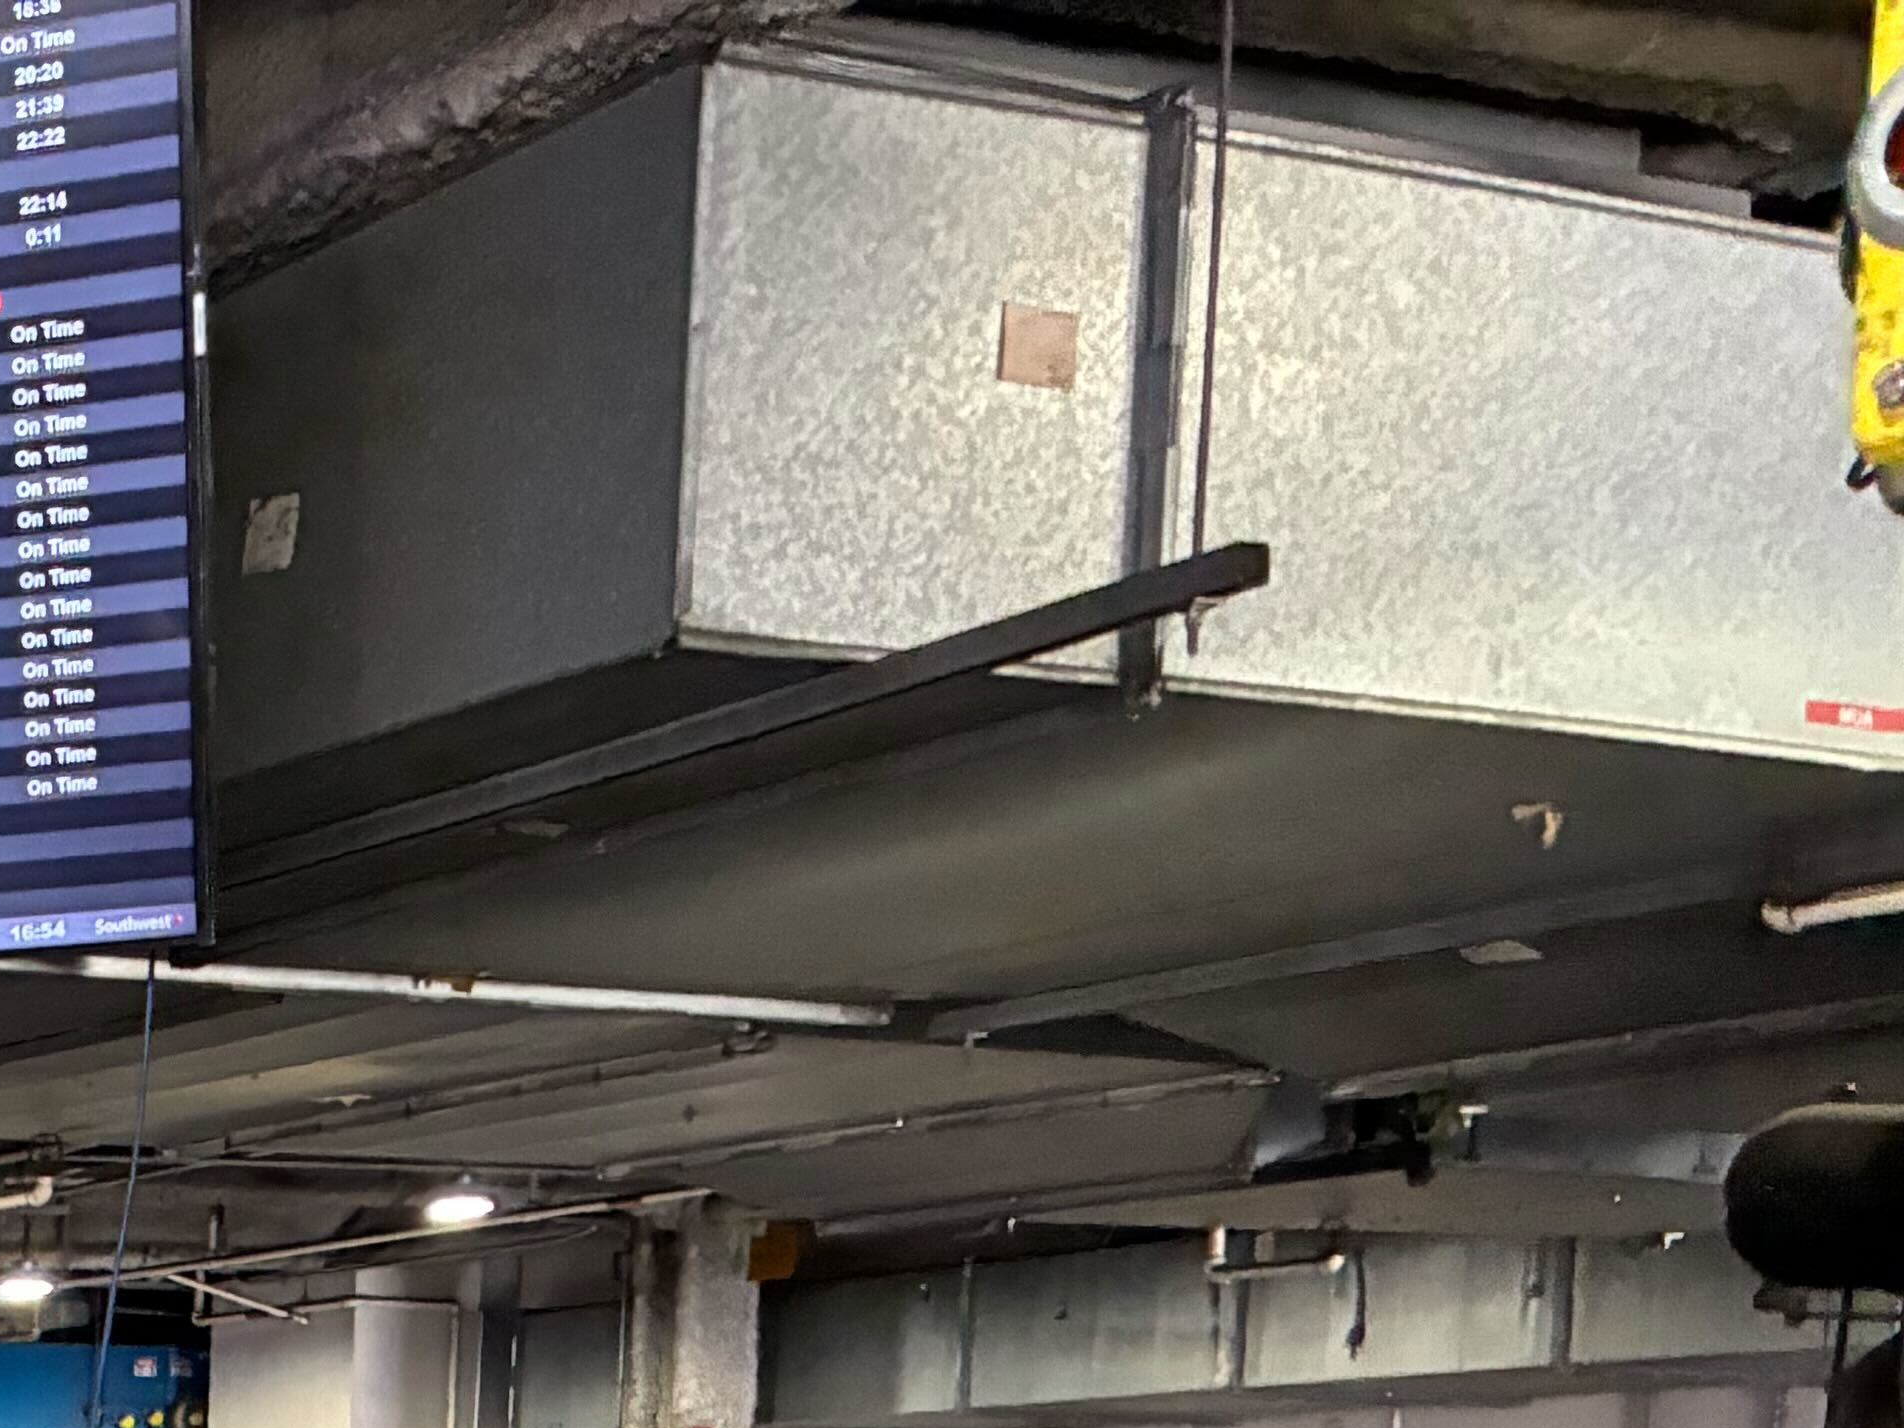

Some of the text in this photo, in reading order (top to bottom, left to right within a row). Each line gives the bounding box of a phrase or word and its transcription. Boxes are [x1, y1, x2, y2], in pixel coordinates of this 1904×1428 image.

[0, 35, 27, 55] On
[33, 29, 76, 50] Time
[14, 61, 64, 86] 20:20
[10, 325, 37, 344] On
[41, 319, 85, 340] Time
[11, 356, 39, 375] On
[42, 352, 86, 372] Time
[12, 387, 40, 406] On
[43, 383, 87, 403] Time
[13, 418, 41, 437] On
[45, 414, 87, 434] Time
[14, 449, 42, 468] On
[46, 444, 88, 464] Time
[15, 480, 42, 498] On
[46, 476, 89, 494] Time
[16, 510, 43, 529] On
[47, 506, 90, 525] Time
[18, 541, 44, 559] On
[48, 537, 91, 556] Time
[18, 571, 46, 590] On
[50, 567, 92, 586] Time
[20, 601, 47, 620] On
[51, 598, 93, 616] Time
[21, 631, 48, 649] On
[52, 627, 94, 647] Time
[22, 661, 49, 679] On
[53, 658, 94, 676] Time
[23, 690, 50, 709] On
[54, 687, 96, 705] Time
[24, 720, 51, 738] On
[56, 717, 96, 735] Time
[25, 750, 52, 768] On
[56, 746, 97, 764] Time
[26, 779, 53, 797] On
[58, 776, 98, 794] Time
[95, 915, 171, 936] Southwest
